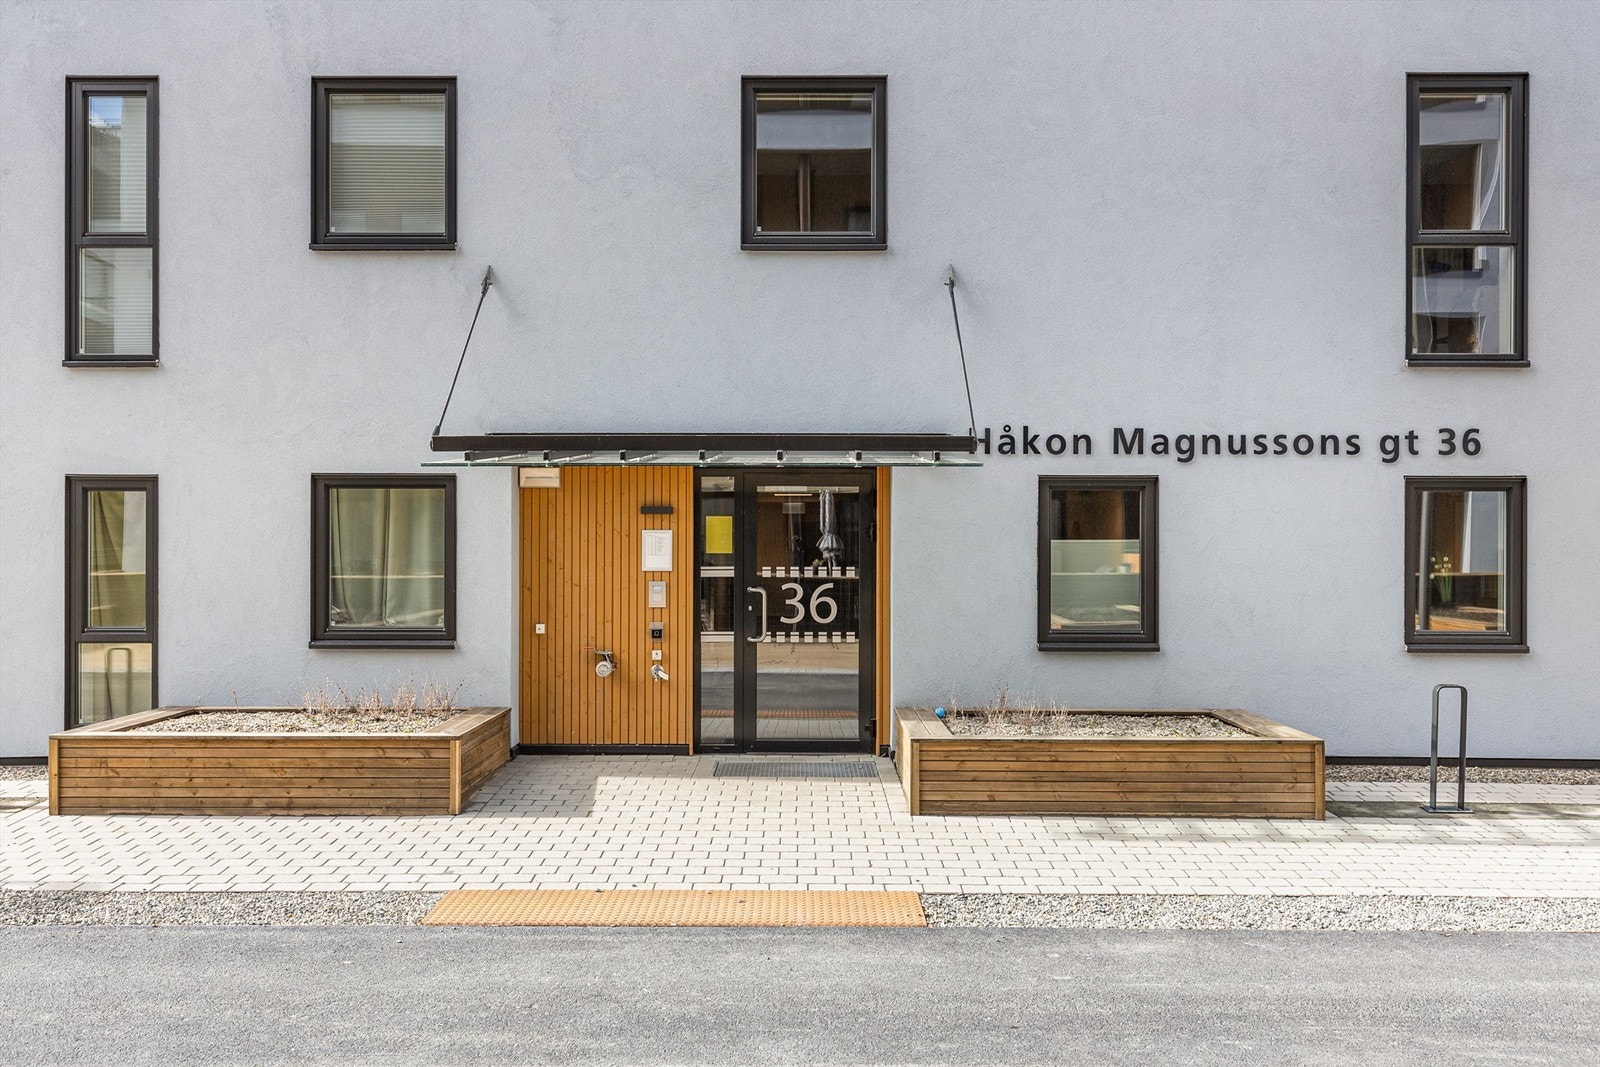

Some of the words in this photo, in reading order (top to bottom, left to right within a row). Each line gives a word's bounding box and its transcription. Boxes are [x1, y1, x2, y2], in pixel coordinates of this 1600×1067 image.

[1114, 427, 1361, 464] Magnussons
[1380, 429, 1419, 464] gt
[1438, 427, 1482, 457] 36
[779, 582, 838, 625] 36
